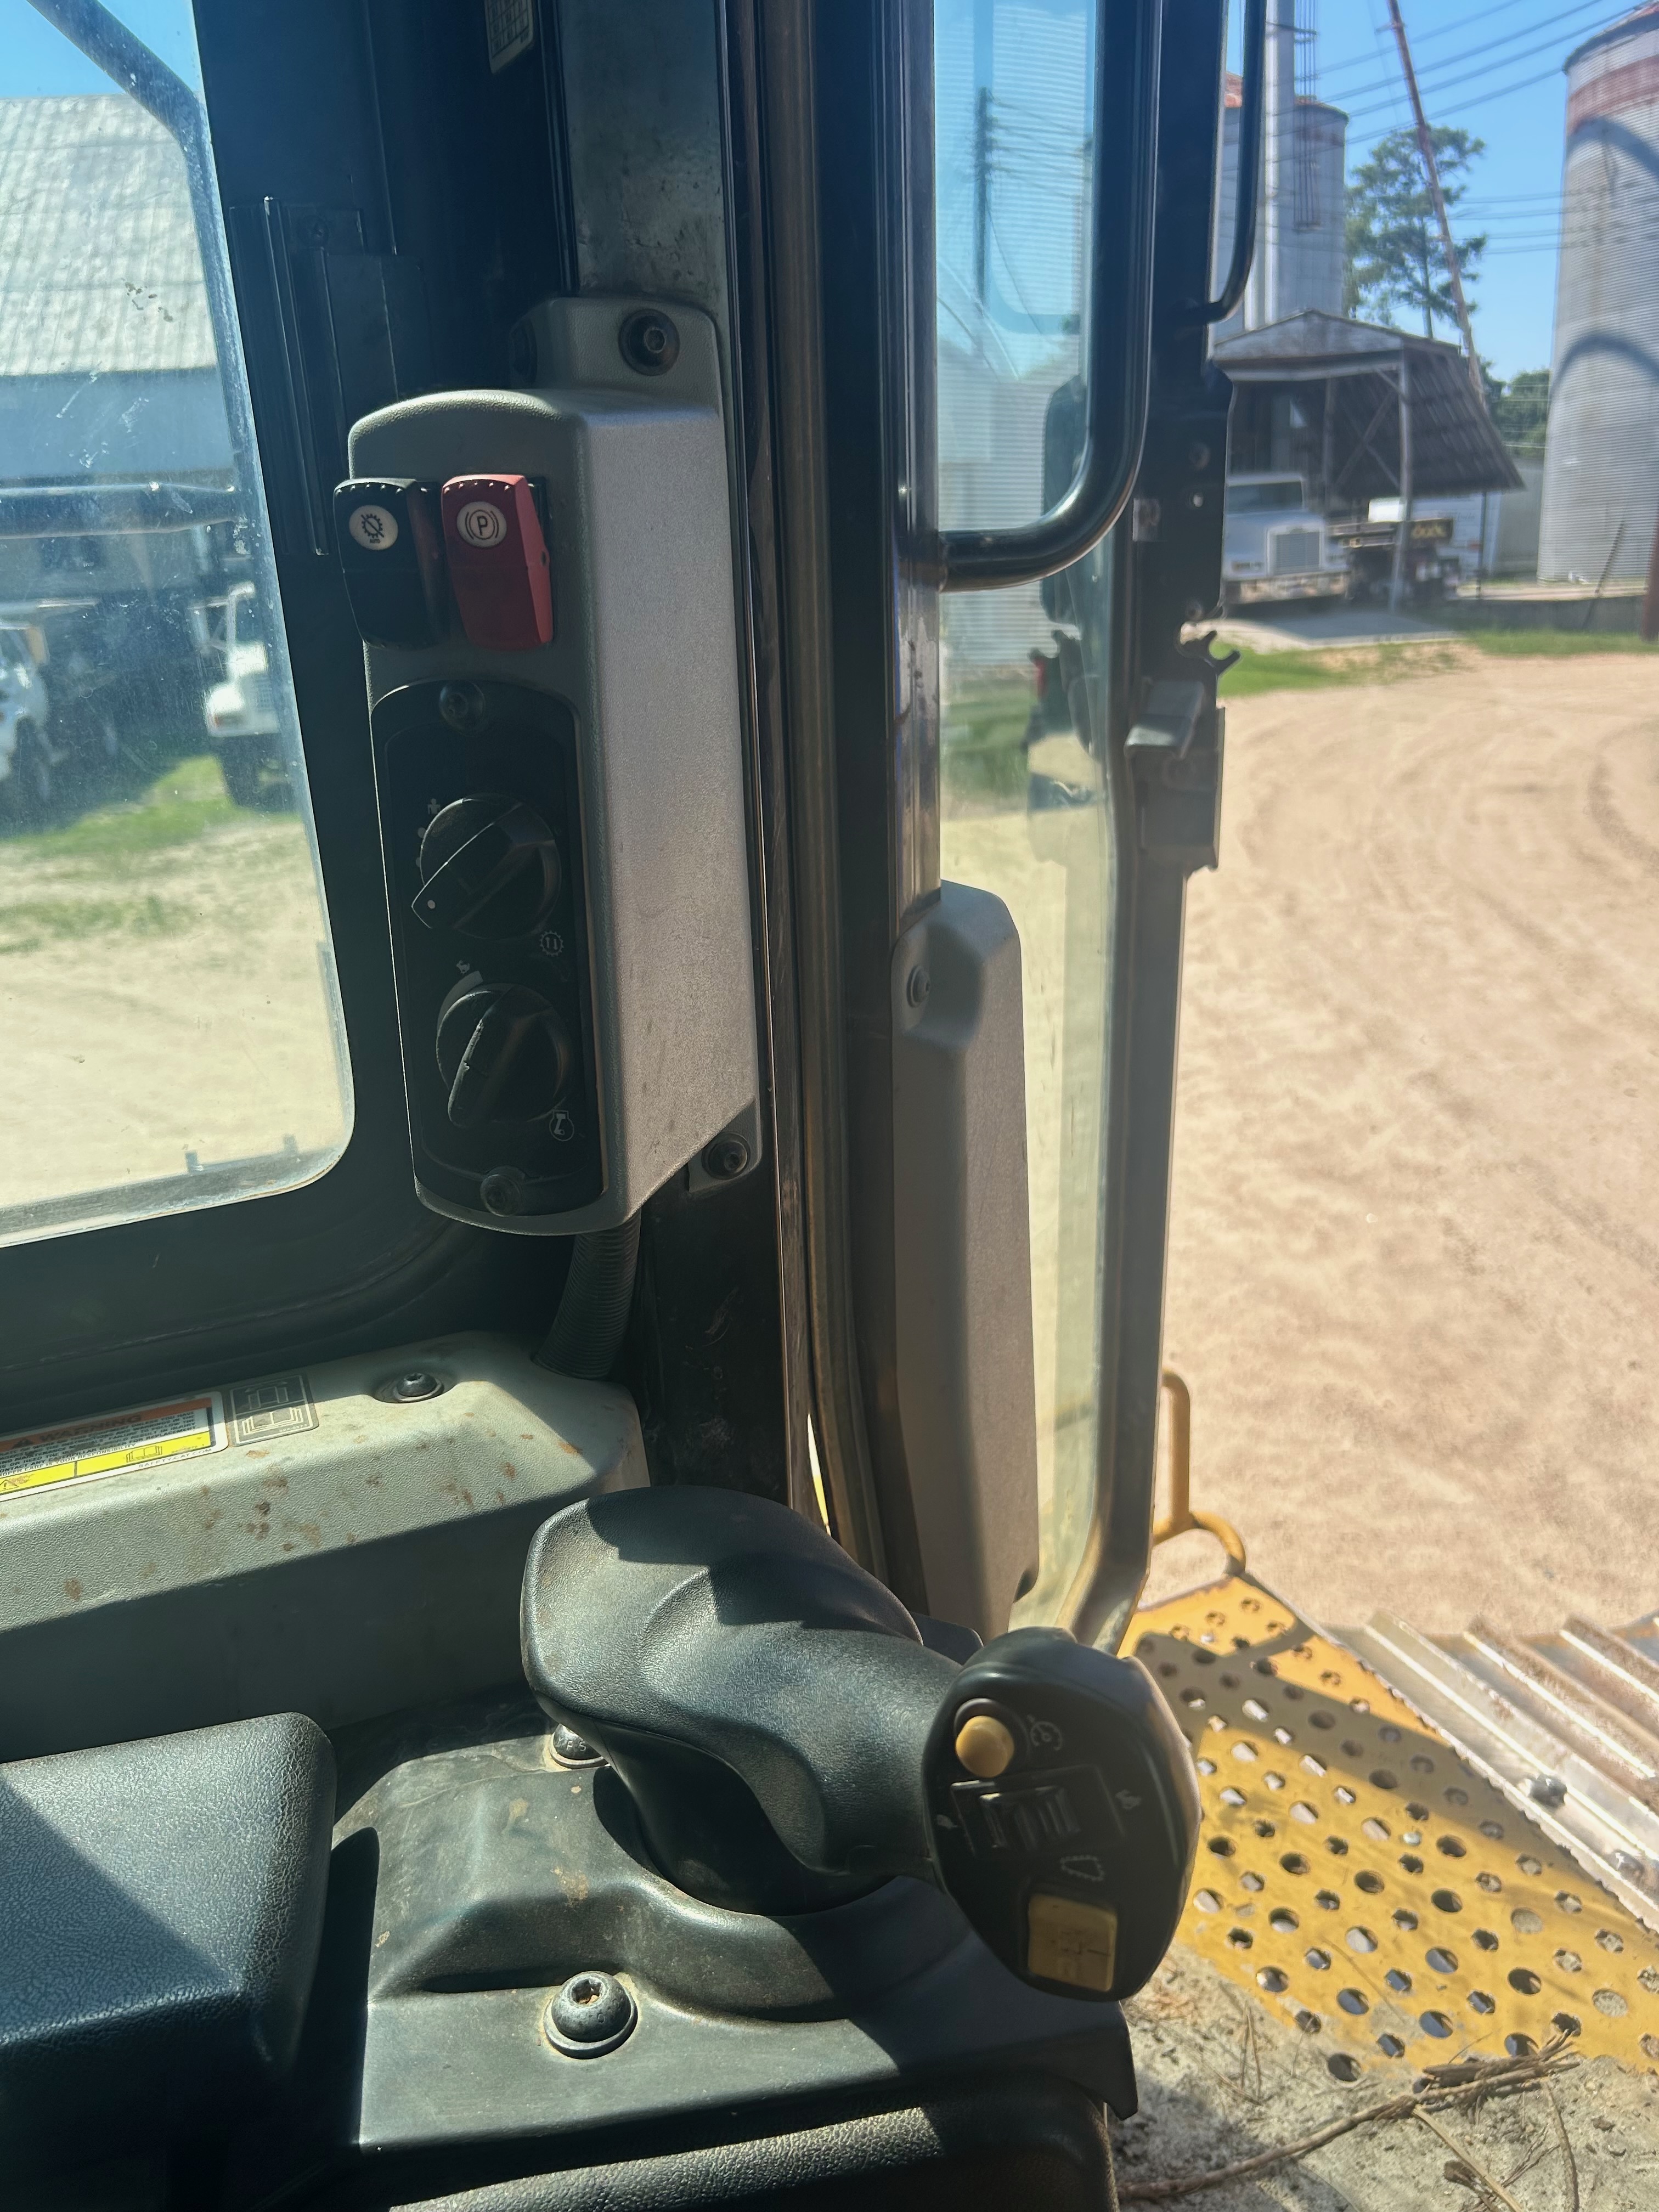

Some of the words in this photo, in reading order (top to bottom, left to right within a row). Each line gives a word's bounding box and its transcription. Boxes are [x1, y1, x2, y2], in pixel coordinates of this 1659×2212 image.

[476, 516, 488, 536] P
[40, 1413, 142, 1443] WARNING
[145, 1426, 195, 1440] REPLACEMENT
